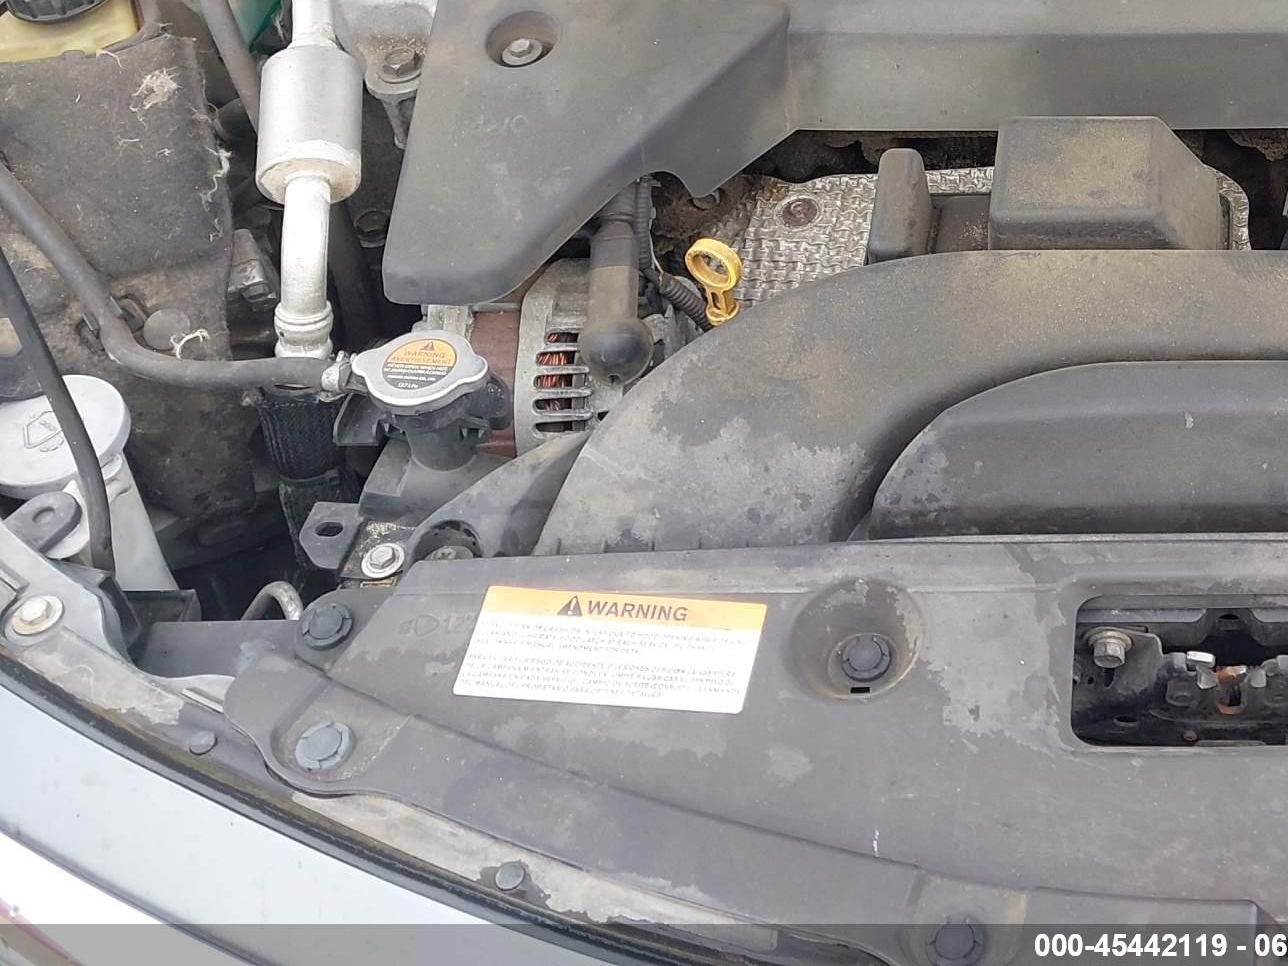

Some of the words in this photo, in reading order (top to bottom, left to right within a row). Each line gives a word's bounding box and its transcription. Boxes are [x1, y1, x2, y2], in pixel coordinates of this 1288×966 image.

[404, 350, 447, 359] WARNING
[391, 356, 452, 365] AVERTISSEMENT
[587, 599, 688, 622] WARNING
